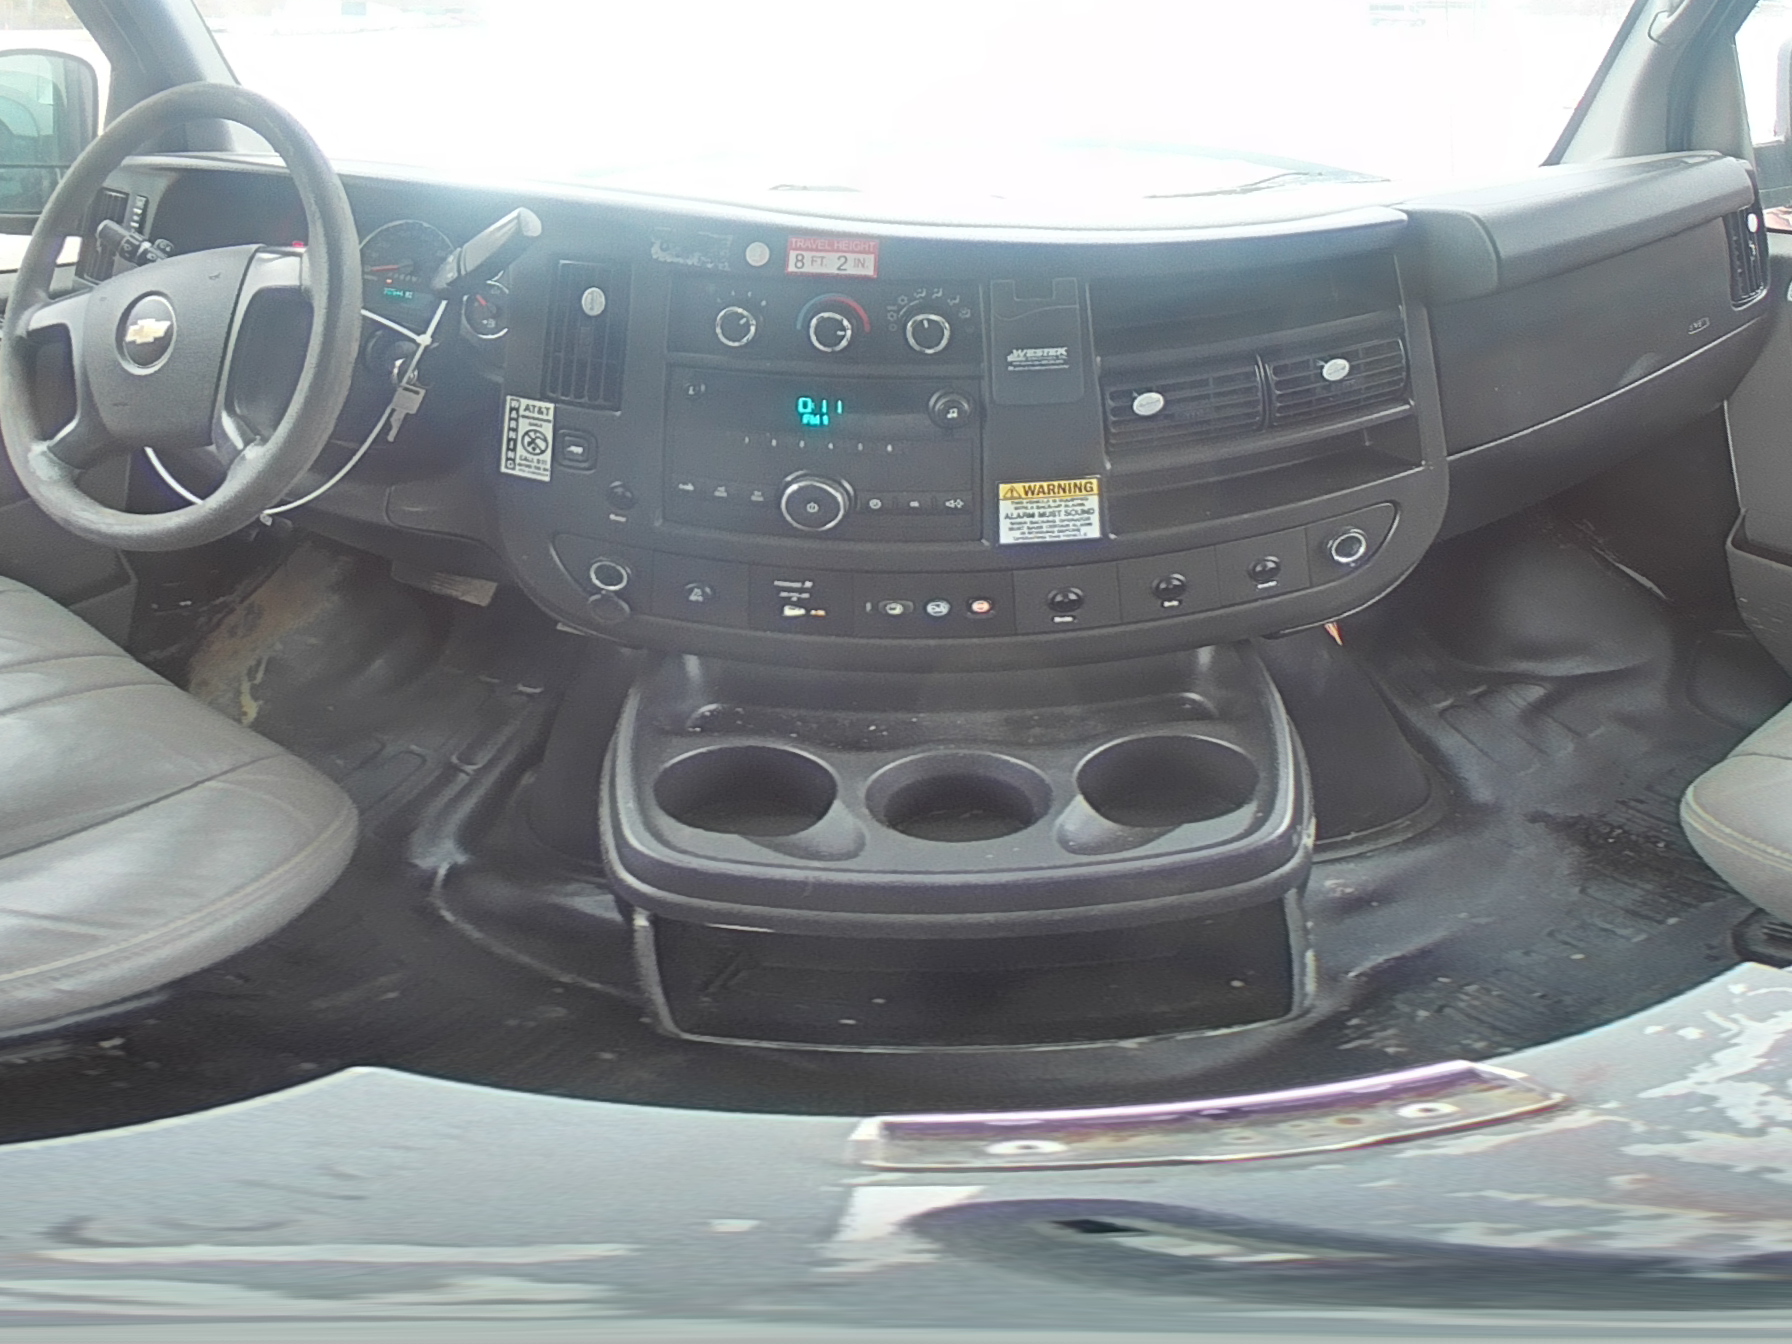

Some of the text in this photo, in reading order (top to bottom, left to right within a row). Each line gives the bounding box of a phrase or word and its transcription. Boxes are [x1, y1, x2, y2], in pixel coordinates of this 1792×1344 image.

[791, 237, 876, 252] TRAVEL HEIGHT
[794, 252, 806, 270] 8
[836, 254, 849, 272] 2
[522, 403, 551, 417] AT&T
[1022, 480, 1094, 497] WARNING
